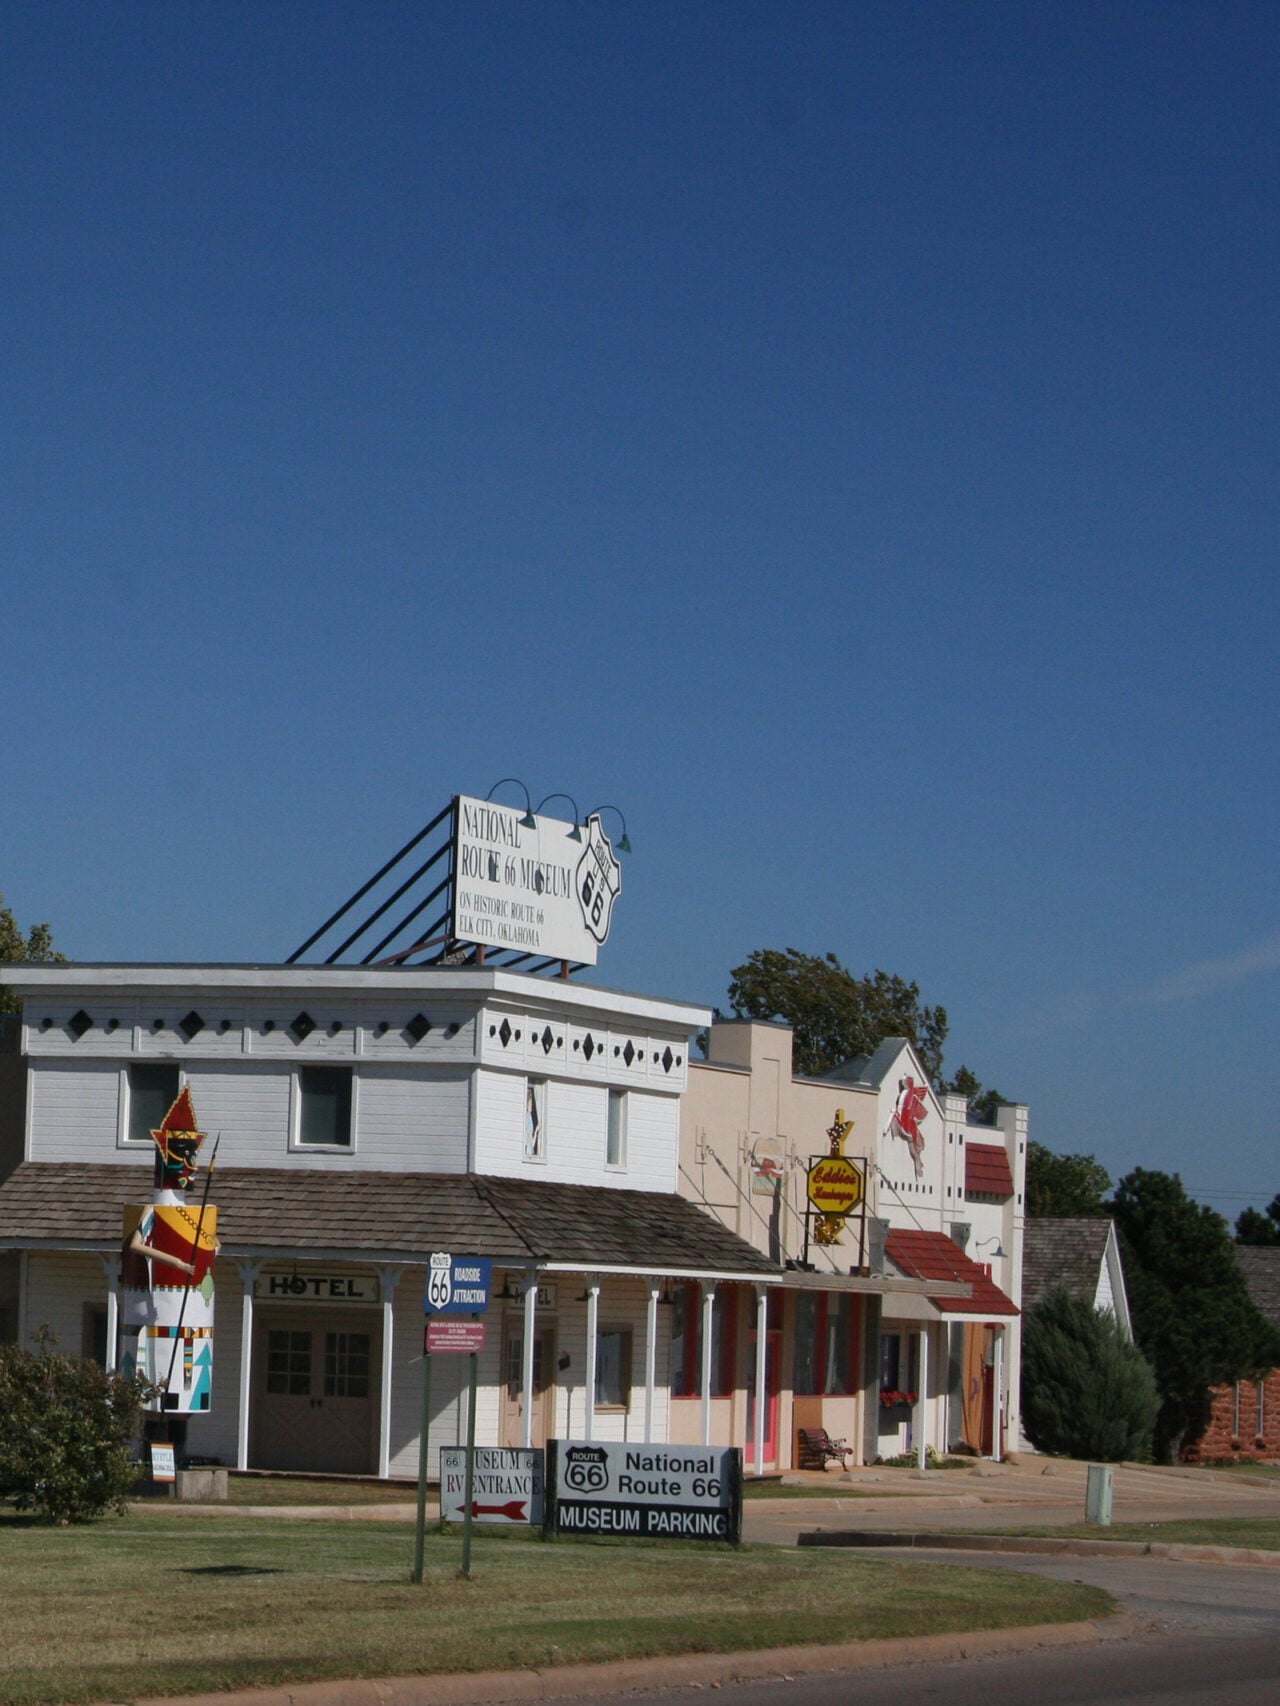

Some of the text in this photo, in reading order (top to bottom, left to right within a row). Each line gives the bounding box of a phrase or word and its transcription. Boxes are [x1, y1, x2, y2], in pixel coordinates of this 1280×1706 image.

[463, 804, 520, 848] NATIONAL
[461, 844, 571, 899] ROUTE 66 MUSEUM
[460, 891, 545, 925] ON HISTORIC ROUTE 66
[582, 871, 604, 927] 66
[460, 915, 540, 947] ELK CITY, OKLAHOMA
[269, 1276, 364, 1297] HOTEL
[431, 1267, 481, 1303] 66 ROADSIDE
[453, 1289, 486, 1304] ATTRACTION
[465, 1450, 519, 1470] USEUM
[572, 1452, 714, 1474] ROUTE National
[447, 1474, 465, 1493] RV
[570, 1463, 721, 1498] 66 Route 66
[559, 1505, 727, 1536] MUSEUM PARKING
